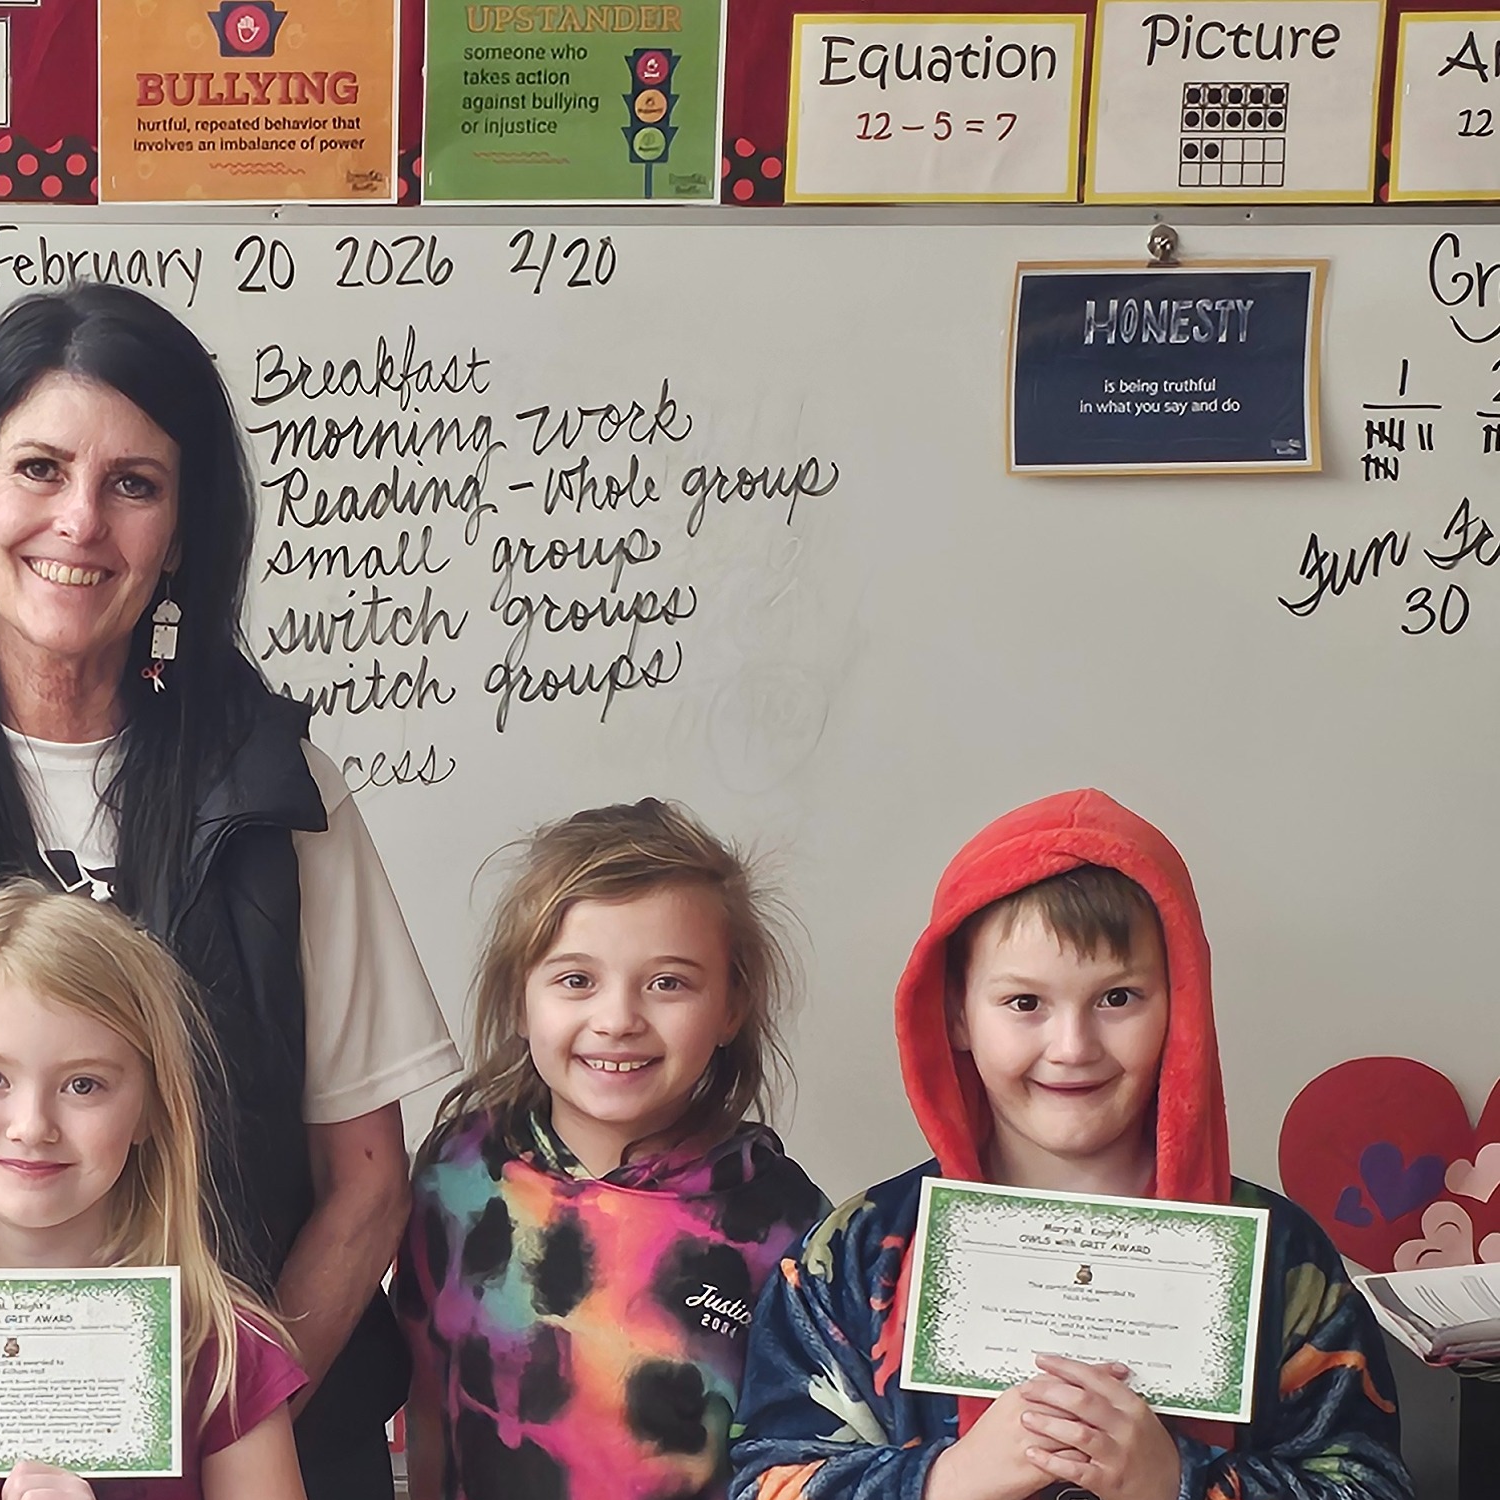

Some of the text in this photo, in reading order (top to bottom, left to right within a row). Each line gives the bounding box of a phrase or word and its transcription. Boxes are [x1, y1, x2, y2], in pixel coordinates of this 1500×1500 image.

[465, 4, 683, 33] UPSTANDER
[463, 44, 588, 60] someone who
[1141, 14, 1340, 66] Picture
[463, 69, 570, 86] takes action
[819, 35, 1057, 90] Equation
[135, 71, 359, 106] BULLYING
[462, 92, 600, 114] against bullying
[137, 116, 360, 134] hurtful, repeated behavior that
[461, 117, 557, 137] or injustice
[856, 111, 893, 141] 12
[934, 111, 953, 141] 5
[996, 112, 1017, 141] 7
[1458, 108, 1494, 139] 12
[134, 136, 366, 154] involves an imbalance of power
[234, 235, 295, 293] 20
[335, 235, 454, 288] 2026
[508, 229, 616, 294] 2/20
[1083, 298, 1254, 345] HONESTY
[251, 325, 490, 410] Breakfast
[1103, 378, 1216, 396] is being truthful
[1079, 398, 1241, 416] in what you say and do
[245, 378, 693, 482] morning work
[260, 460, 498, 546] Reading
[681, 457, 839, 538] group
[261, 526, 662, 610] small group
[1400, 583, 1470, 636] 30
[261, 585, 697, 668] switch groups
[484, 641, 682, 733] groups
[343, 745, 457, 795] cess
[1018, 1233, 1052, 1246] OWLS
[1079, 1239, 1106, 1250] GRIT
[1110, 1243, 1151, 1255] AWARD
[4, 1315, 31, 1324] GRIT
[34, 1315, 73, 1324] AWARD
